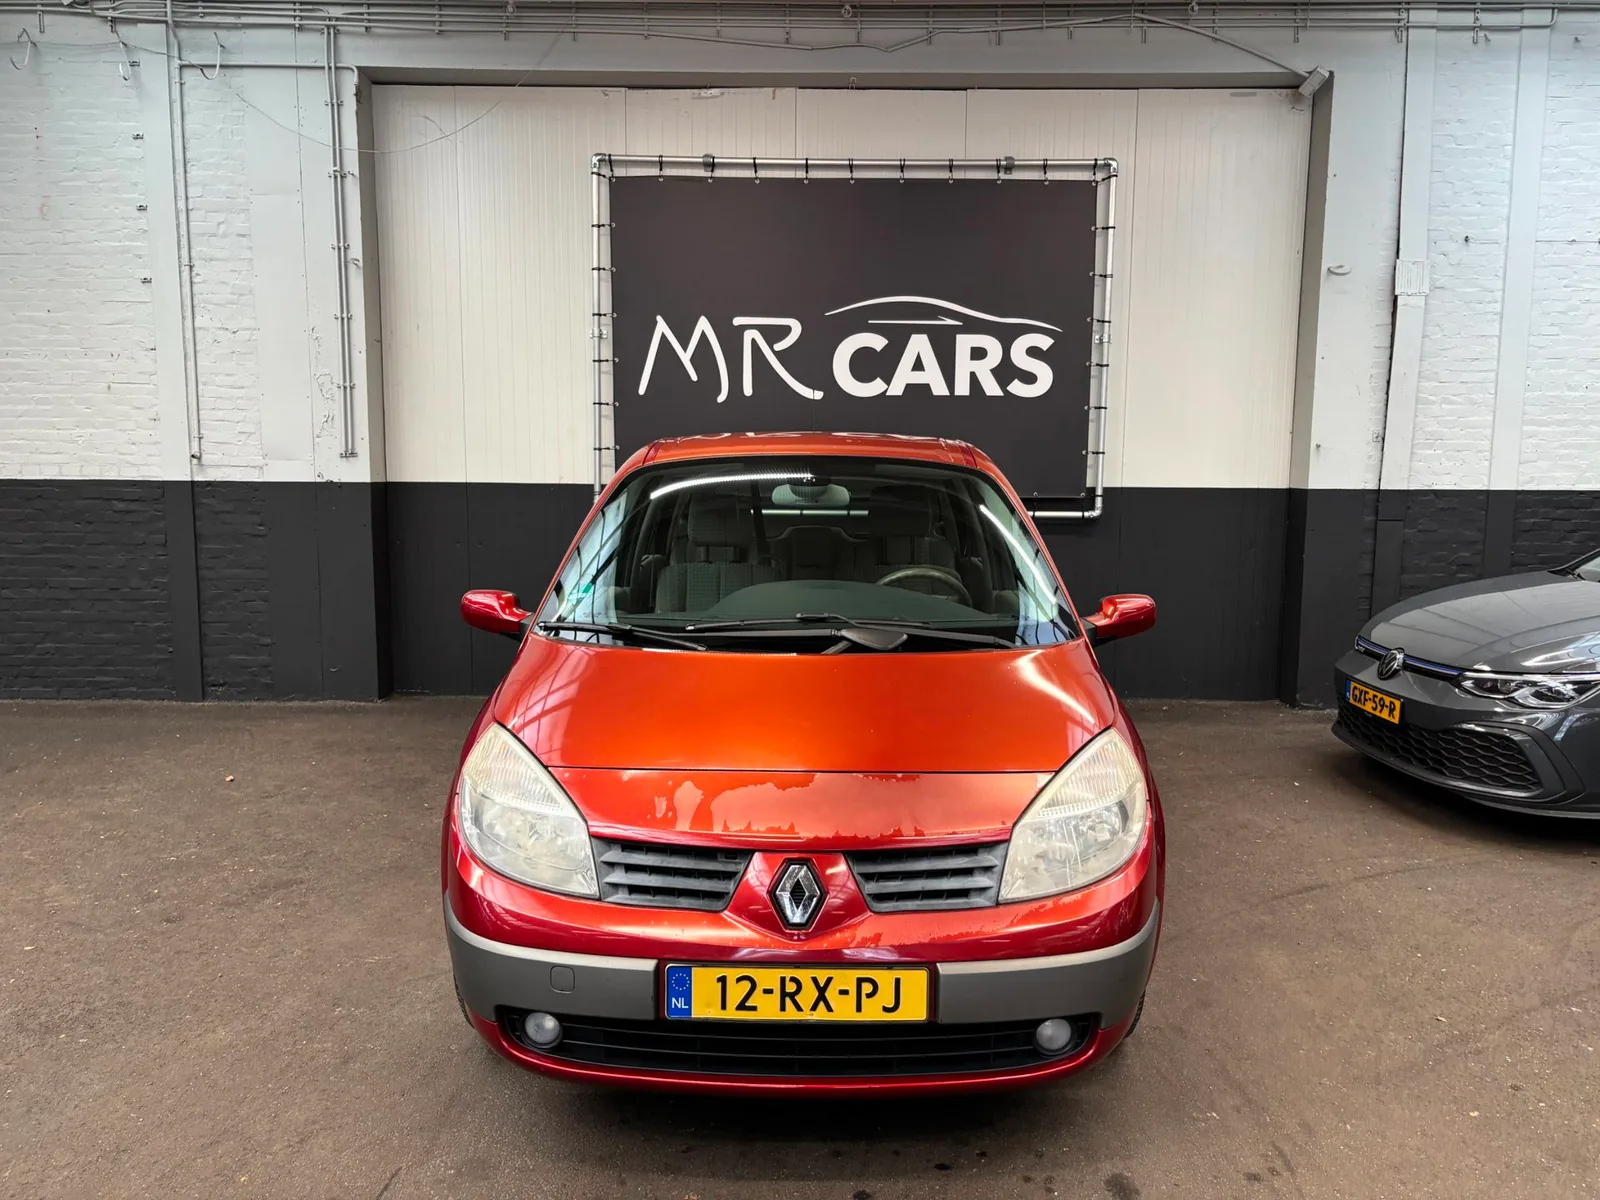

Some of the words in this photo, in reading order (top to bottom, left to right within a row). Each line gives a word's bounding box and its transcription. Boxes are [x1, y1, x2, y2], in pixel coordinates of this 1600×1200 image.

[638, 315, 824, 403] MR
[832, 332, 1055, 398] CARS
[1351, 685, 1396, 719] GXF-59-R
[671, 997, 689, 1009] NL
[715, 974, 901, 1013] 12-RX-PJ
